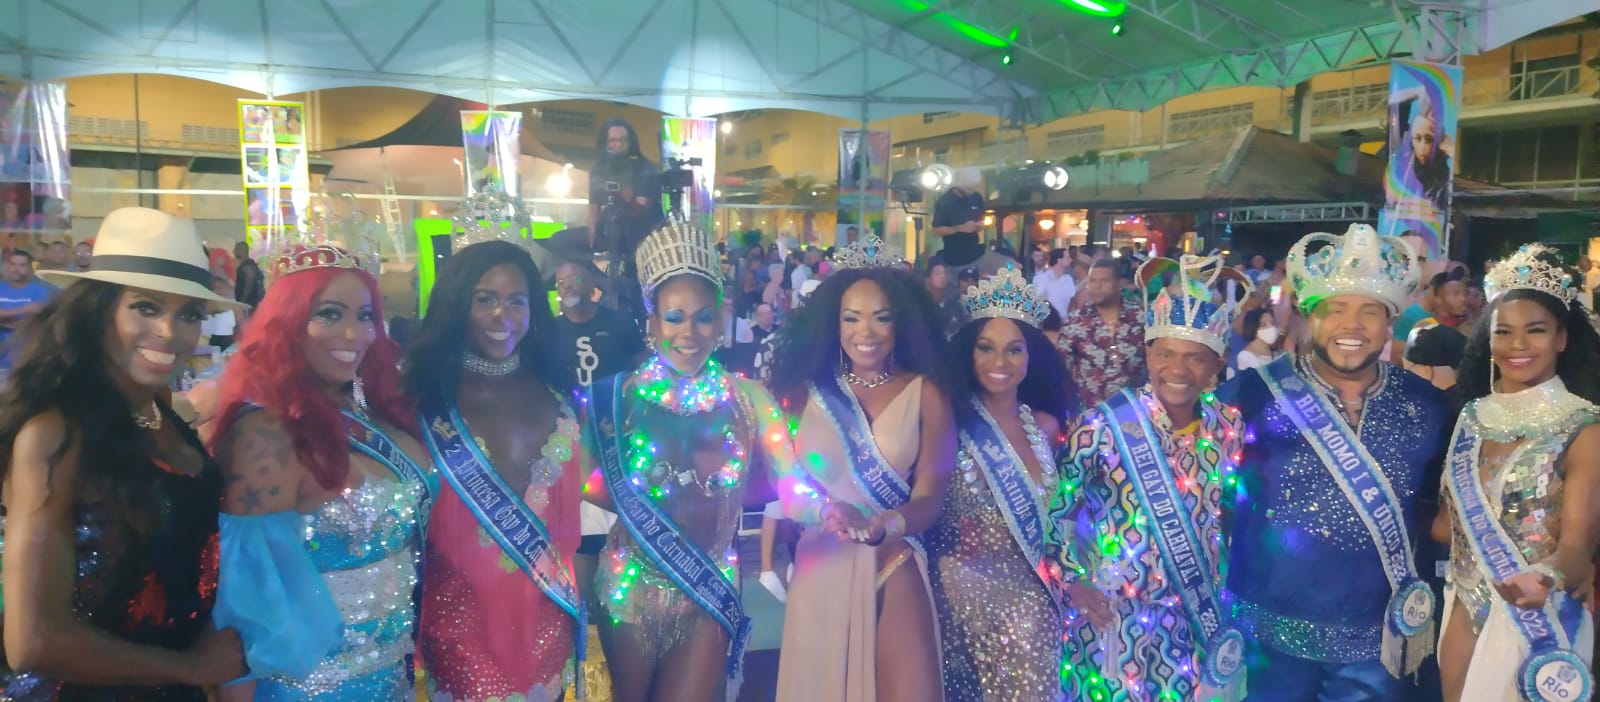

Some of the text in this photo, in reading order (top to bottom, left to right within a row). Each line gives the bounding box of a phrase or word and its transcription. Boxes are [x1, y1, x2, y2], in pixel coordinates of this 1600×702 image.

[1130, 442, 1155, 468] REI
[1295, 393, 1326, 424] REI
[1317, 422, 1361, 471] MOMO
[1362, 486, 1379, 503] &
[997, 464, 1034, 520] Rainha
[1142, 469, 1167, 497] GAY
[453, 457, 500, 510] Princesa
[513, 522, 530, 545] do
[1152, 498, 1174, 517] DO
[642, 514, 660, 536] do
[1162, 518, 1200, 584] CARNAVAL
[1406, 606, 1426, 621] Rio
[1221, 654, 1236, 670] Rio
[1543, 676, 1569, 698] Rio
